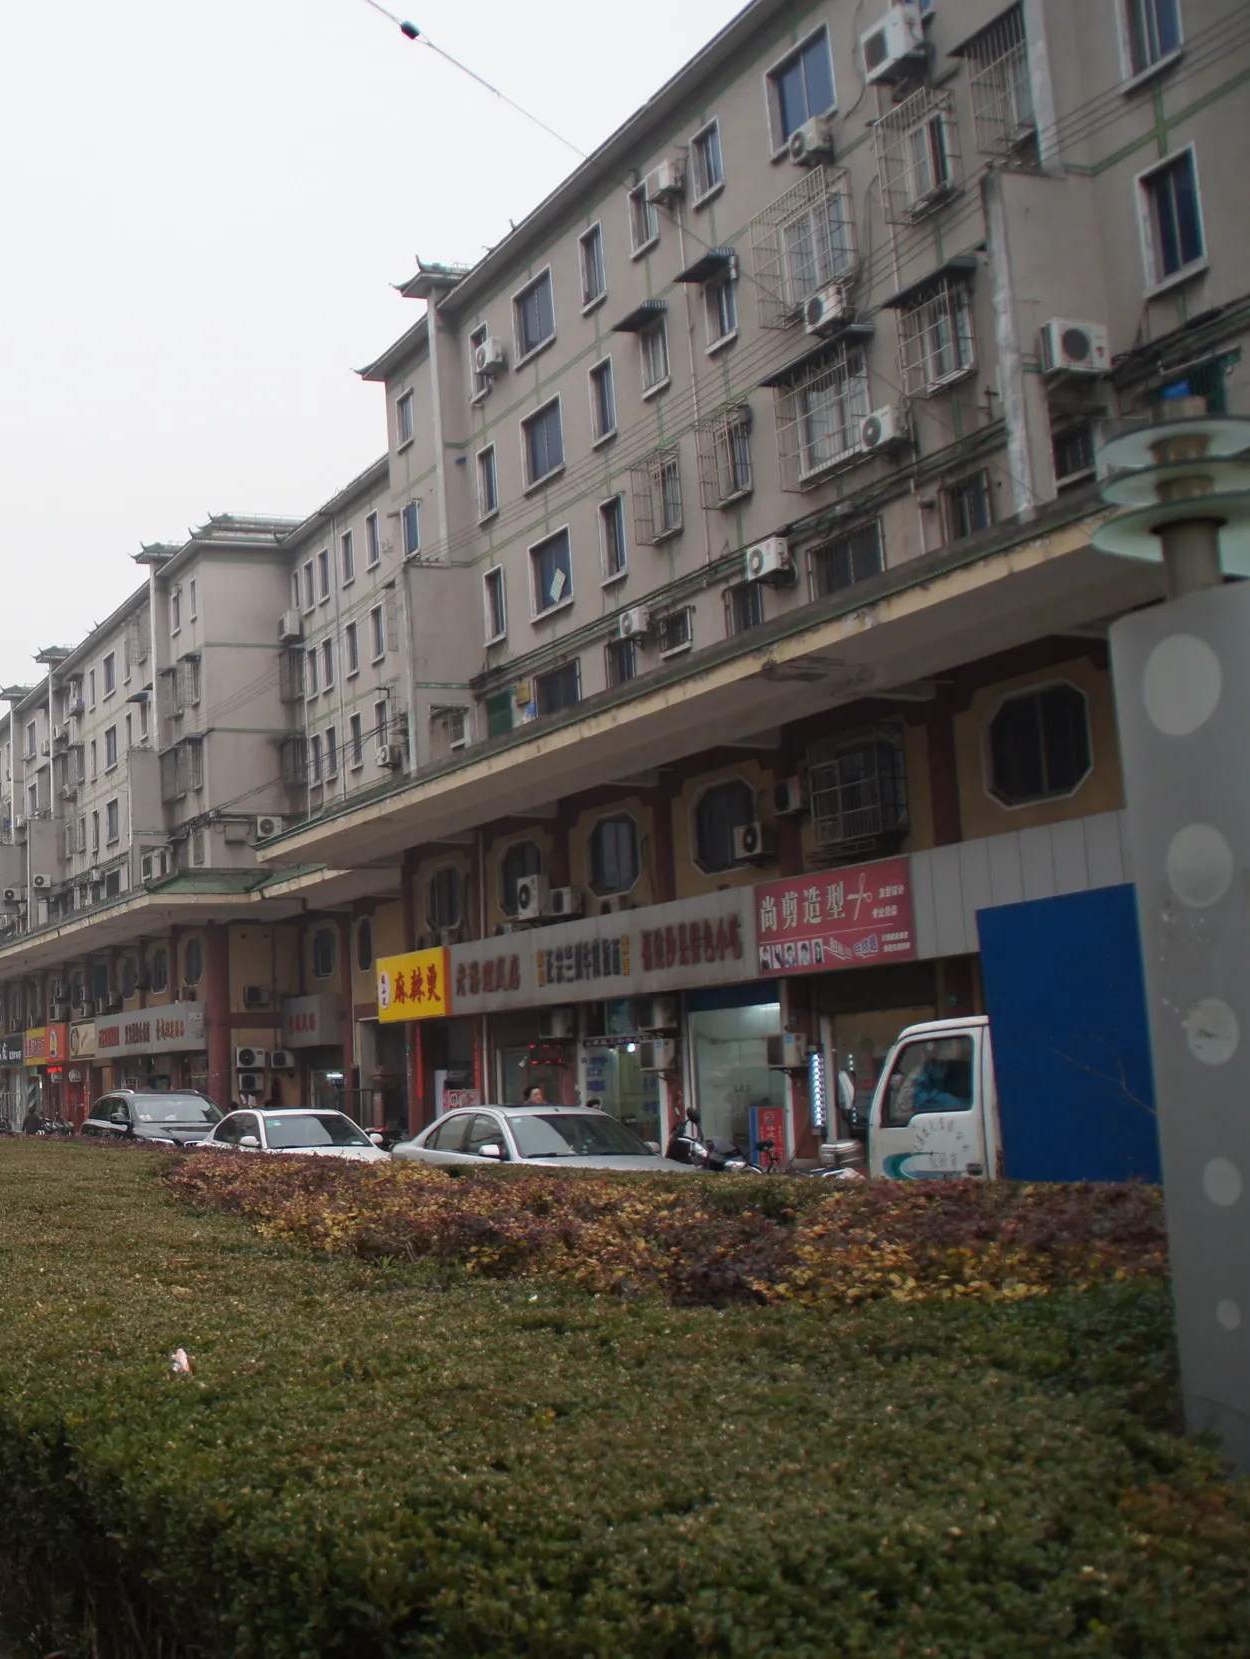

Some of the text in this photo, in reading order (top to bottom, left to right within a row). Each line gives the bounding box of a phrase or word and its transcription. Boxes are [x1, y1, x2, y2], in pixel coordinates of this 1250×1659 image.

[759, 880, 847, 934] 尚剪造型
[393, 962, 442, 1005] 麻辣烫
